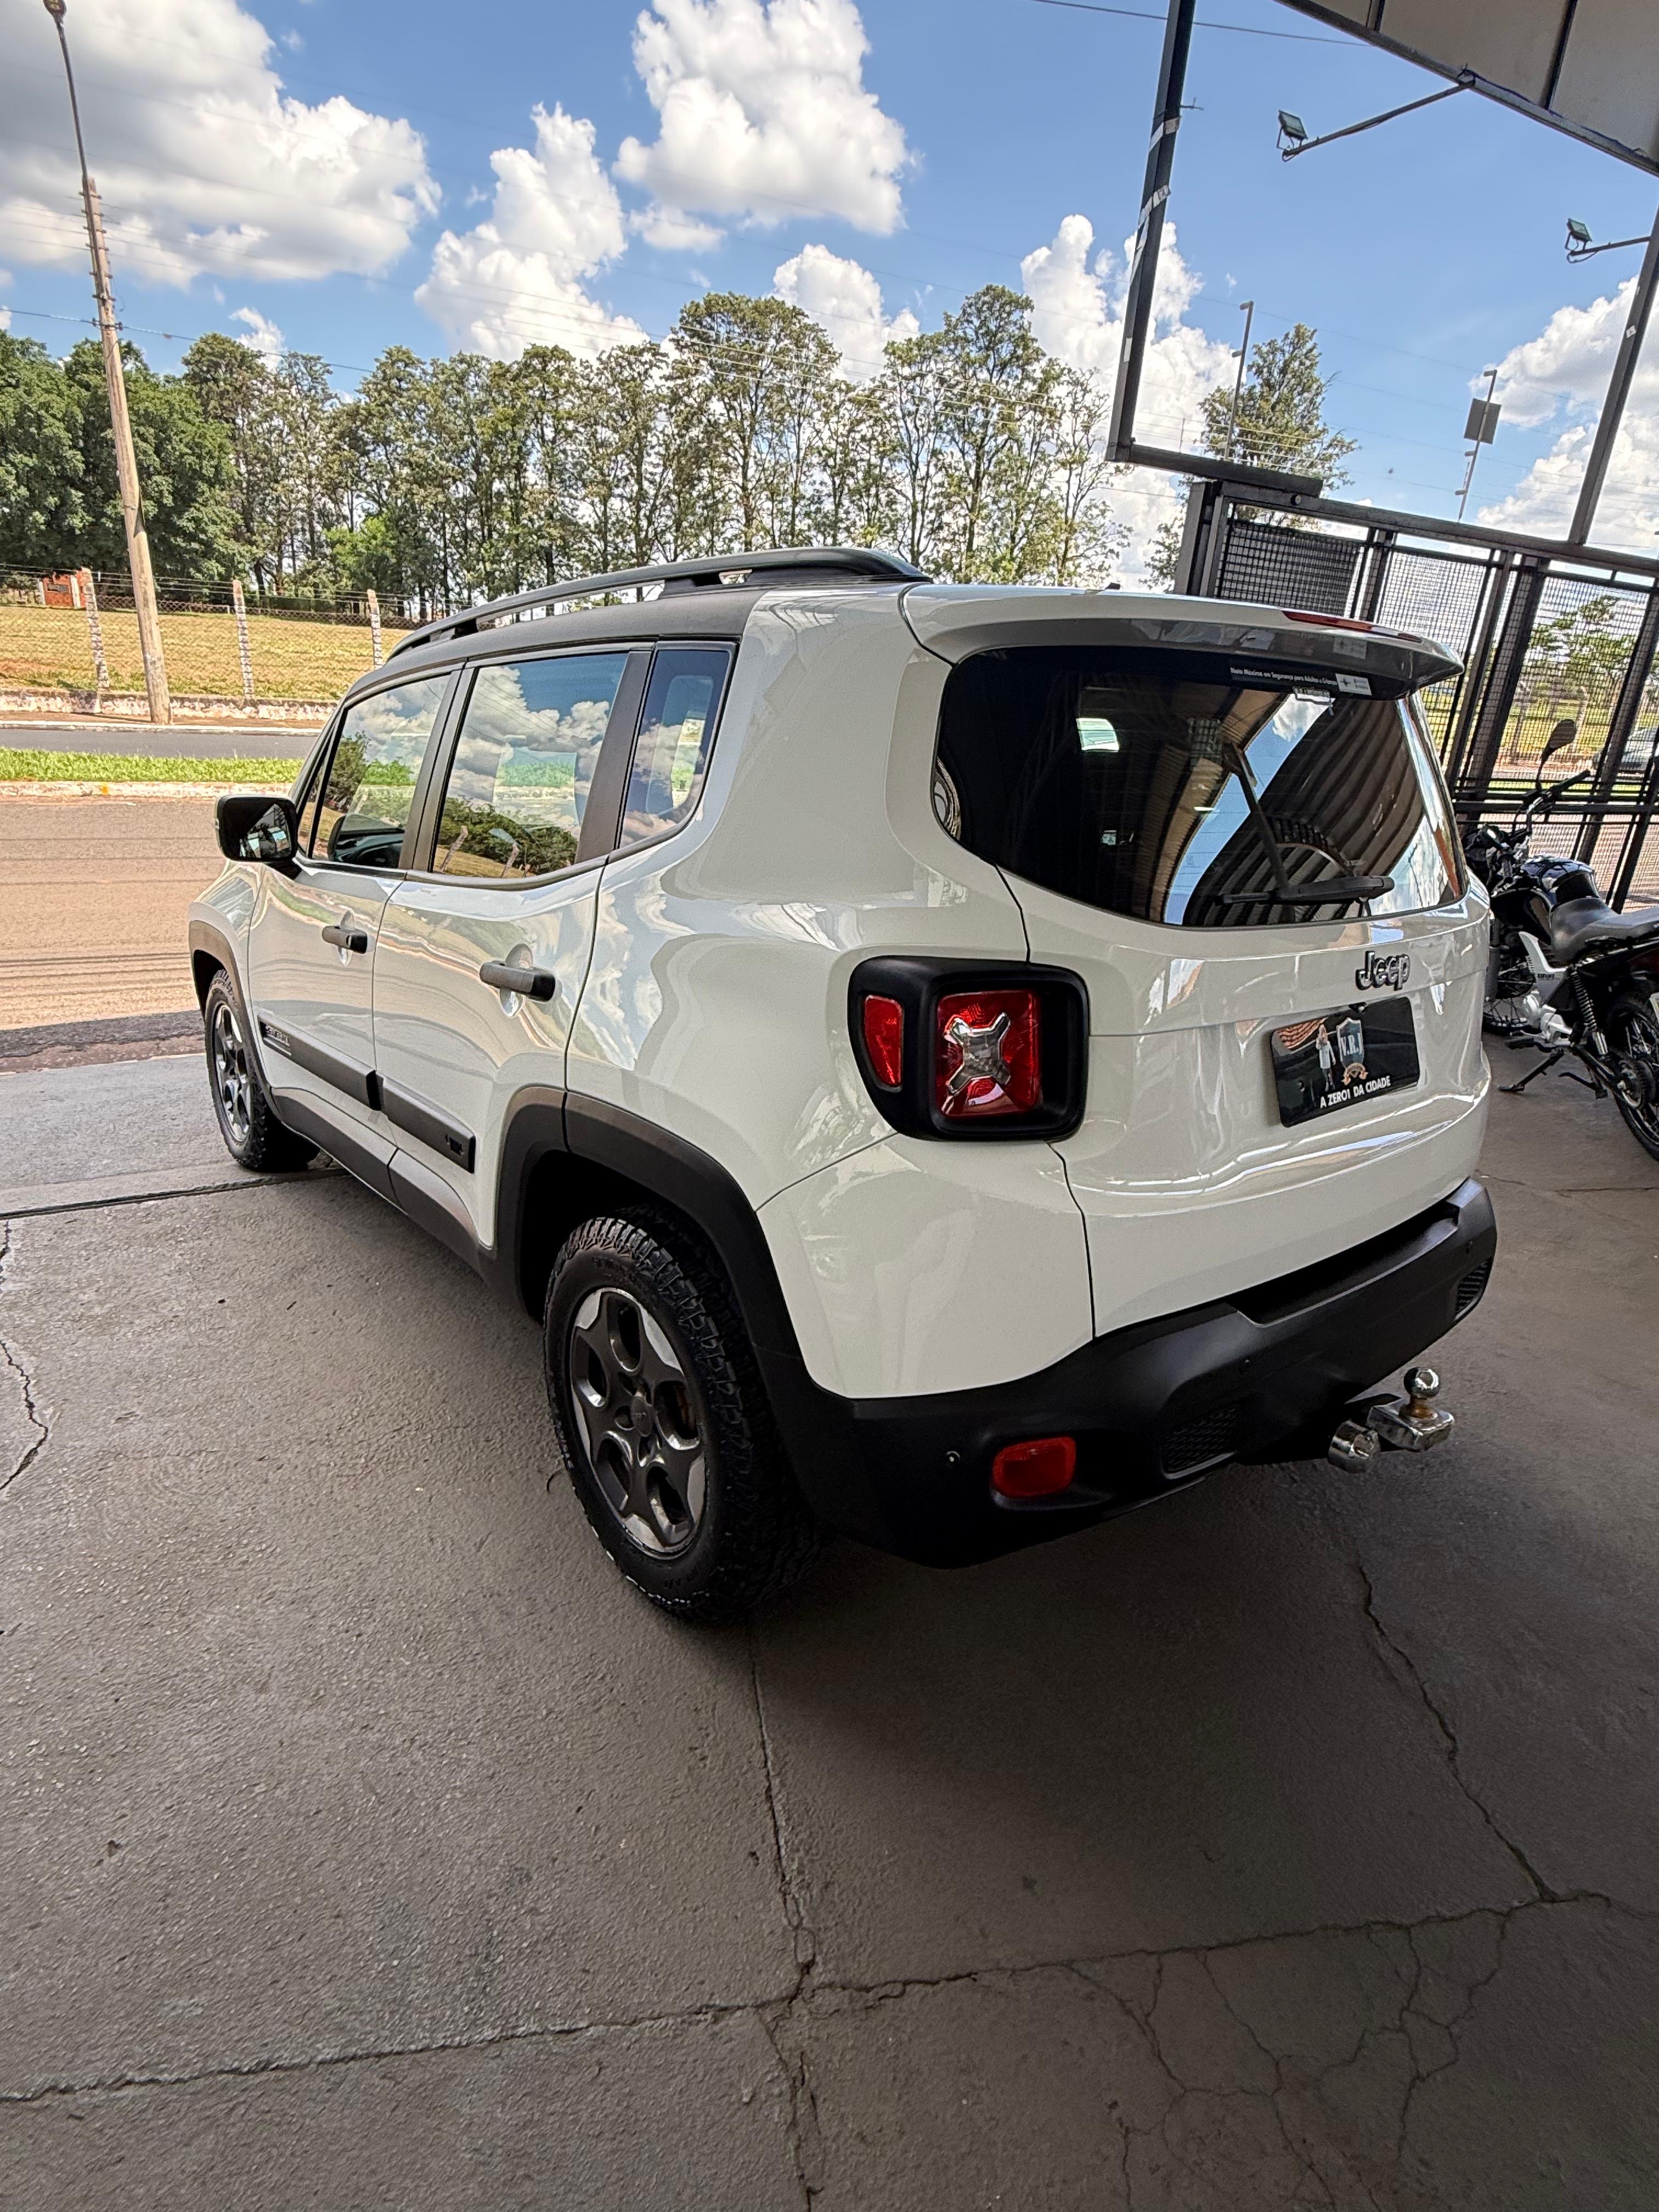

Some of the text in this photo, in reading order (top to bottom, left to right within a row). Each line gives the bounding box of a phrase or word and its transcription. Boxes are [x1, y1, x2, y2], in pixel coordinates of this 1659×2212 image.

[1356, 951, 1410, 991] Jeep
[1320, 1096, 1327, 1108] A
[1353, 1084, 1365, 1097] DA
[1365, 1075, 1391, 1093] CIDADE
